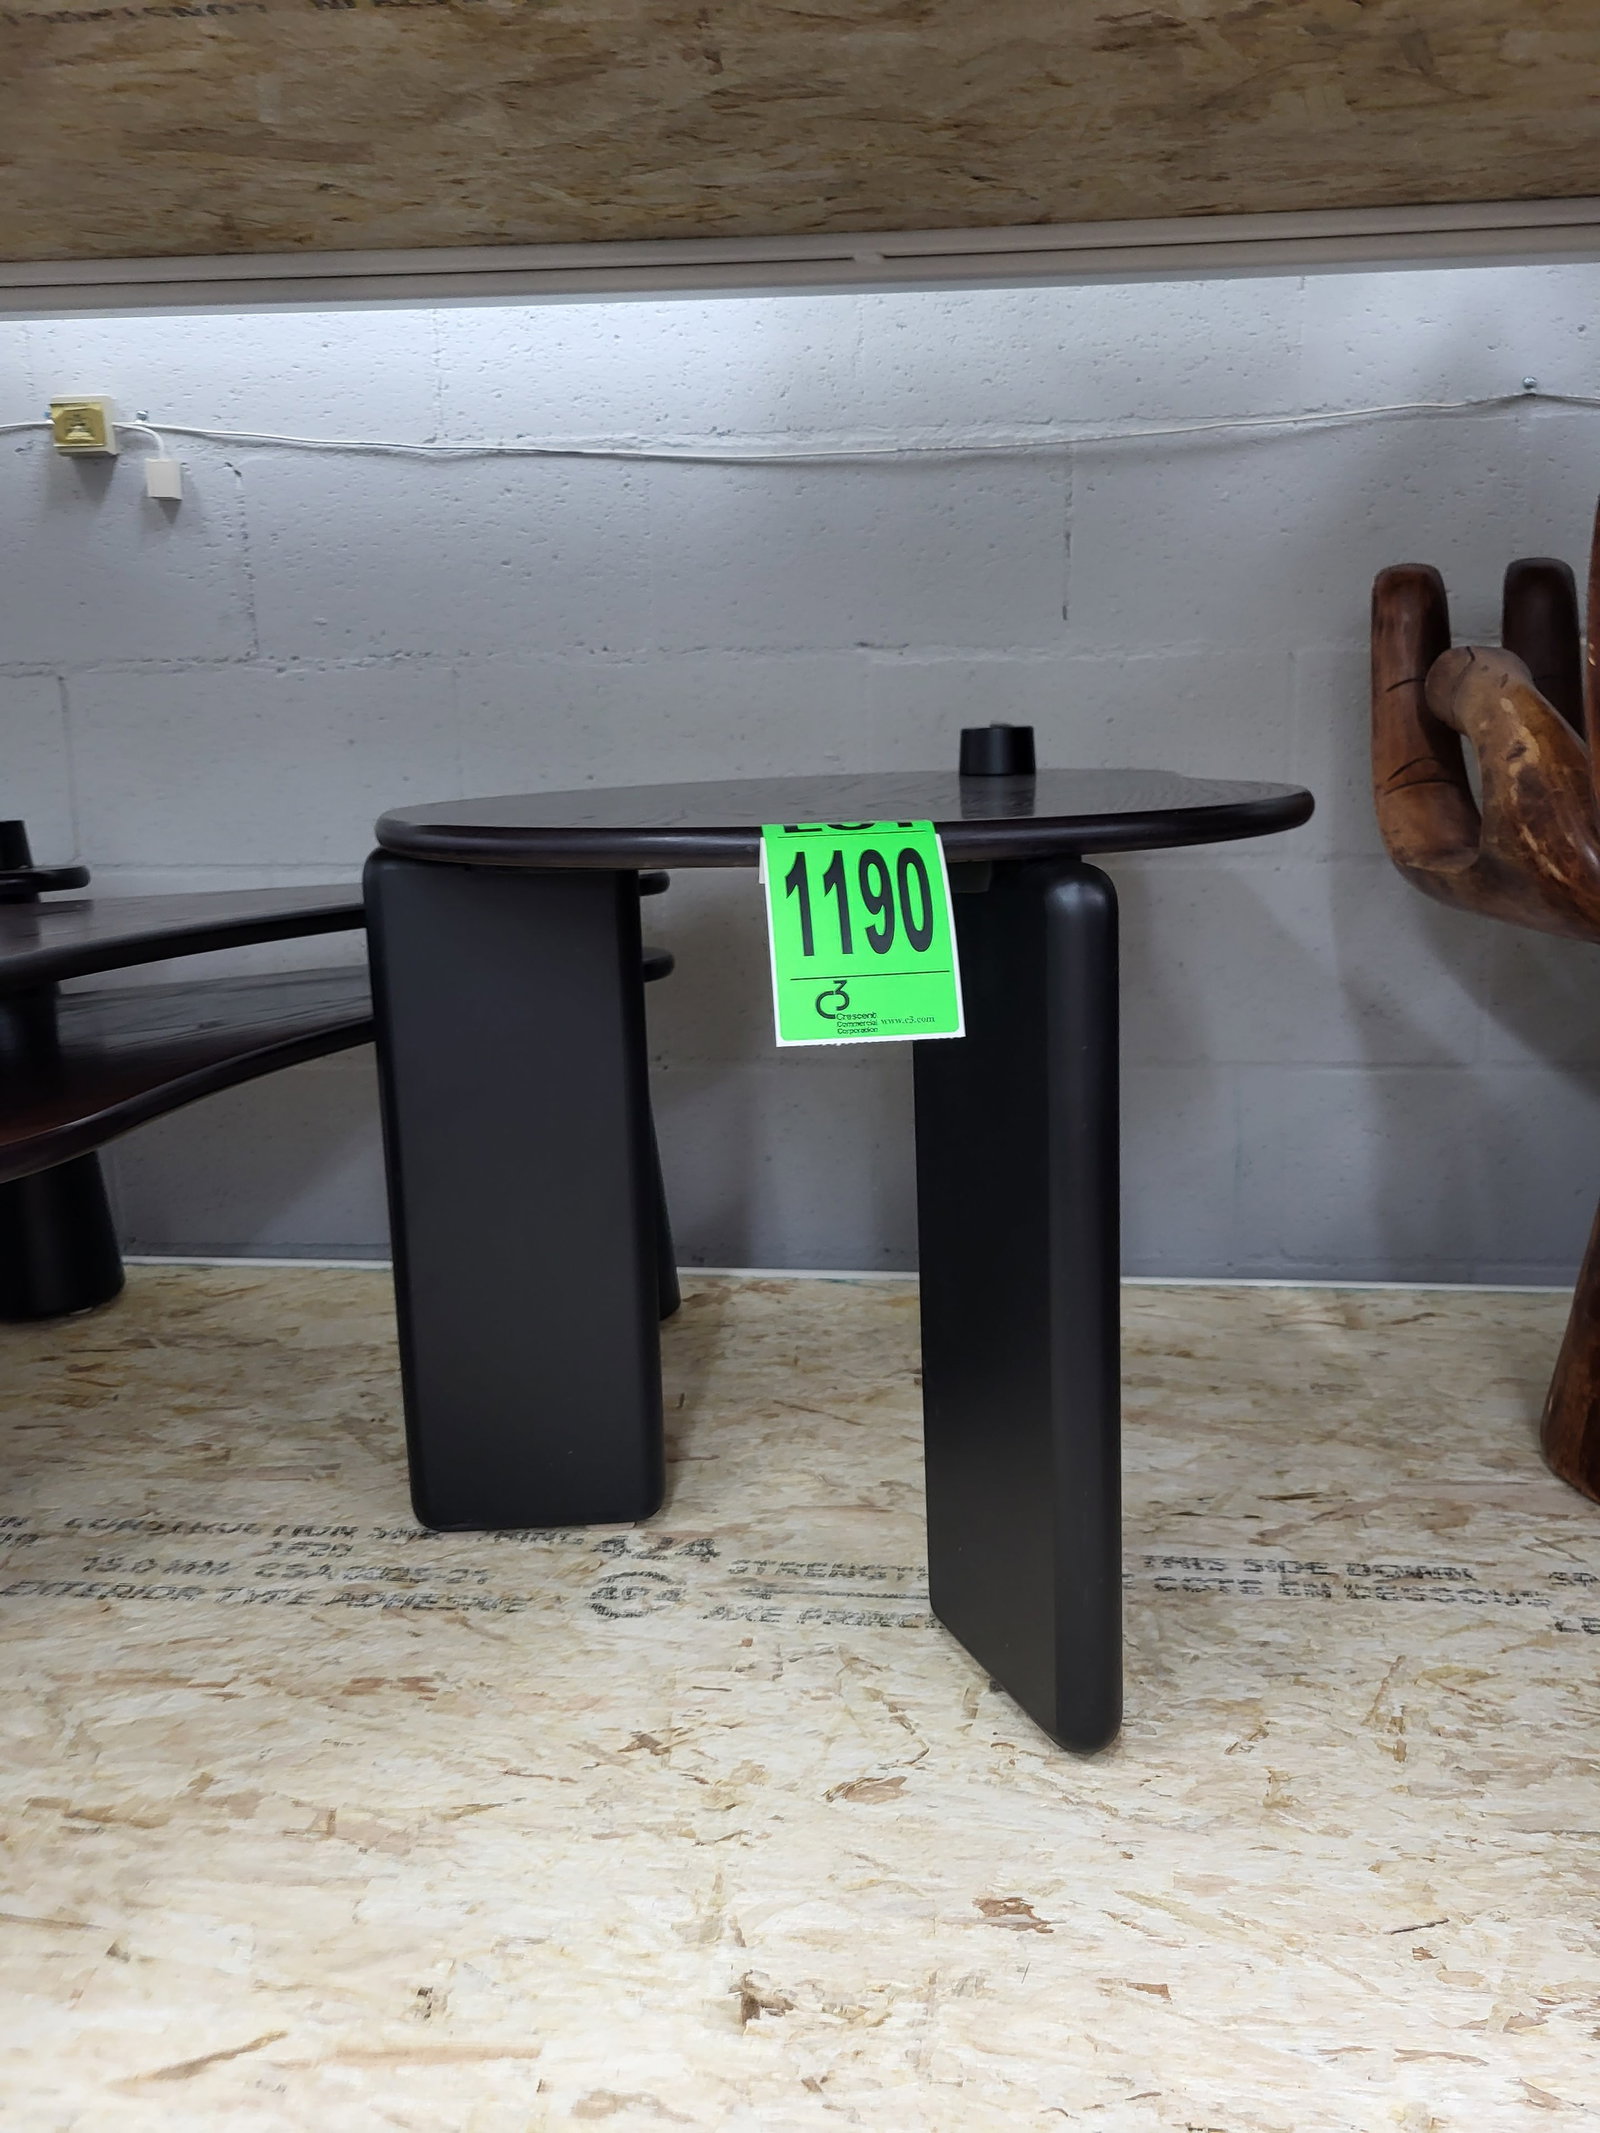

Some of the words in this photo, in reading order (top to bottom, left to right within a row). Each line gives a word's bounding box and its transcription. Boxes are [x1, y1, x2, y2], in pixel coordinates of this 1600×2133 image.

[785, 847, 934, 957] 1190
[836, 1012, 877, 1020] Crescent
[880, 1016, 936, 1024] www.c3.com
[836, 1019, 878, 1027] Commercial
[837, 1026, 879, 1034] Corporation
